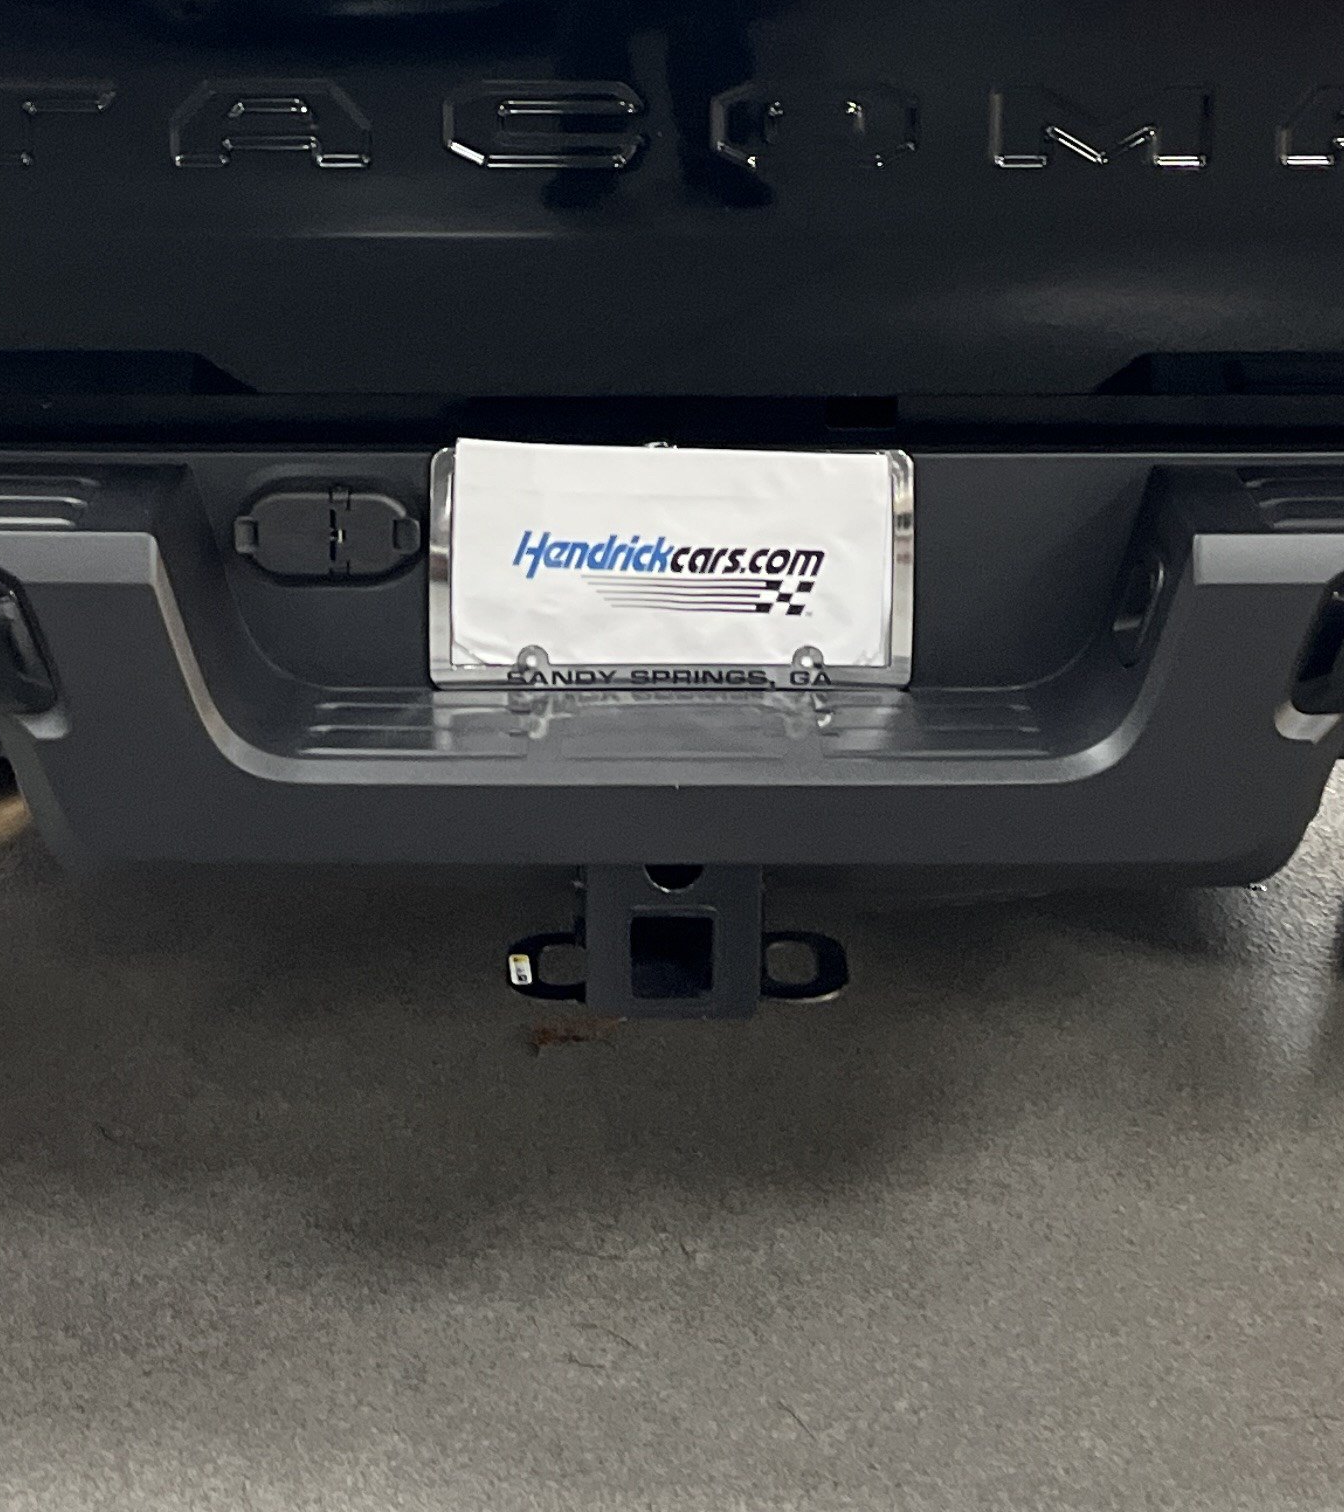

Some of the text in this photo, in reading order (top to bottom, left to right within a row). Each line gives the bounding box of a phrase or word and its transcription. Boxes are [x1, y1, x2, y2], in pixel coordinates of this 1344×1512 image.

[512, 529, 826, 580] Hendrickcars.com
[506, 669, 833, 688] SANDY SPRINGS, GA
